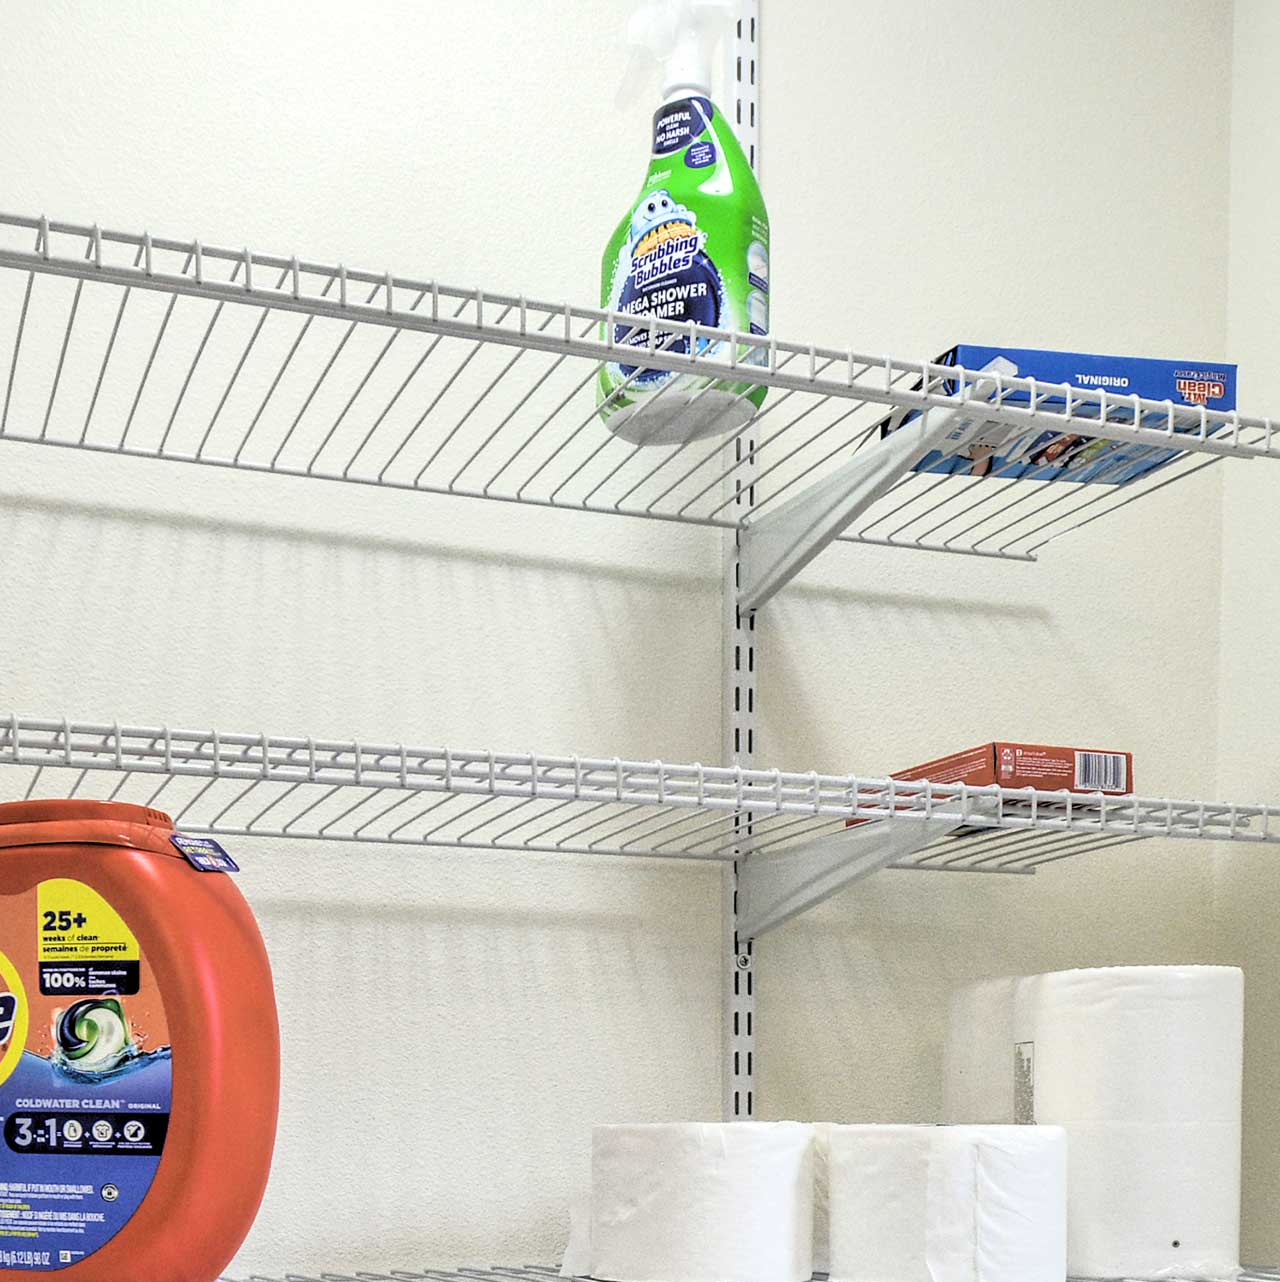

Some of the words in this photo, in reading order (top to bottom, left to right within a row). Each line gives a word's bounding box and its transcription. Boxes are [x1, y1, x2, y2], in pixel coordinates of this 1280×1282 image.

[631, 236, 699, 273] Scrubbing
[635, 255, 692, 287] Bubbles
[651, 283, 708, 306] SHOWER
[1075, 374, 1129, 388] ORIGINAL
[1176, 379, 1225, 398] Clean
[42, 910, 87, 931] 25+
[42, 934, 66, 942] weeks
[42, 945, 78, 953] semaines
[42, 972, 86, 988] 100%
[15, 1098, 80, 1109] COLDWATER
[128, 1102, 162, 1110] ORIGINAL
